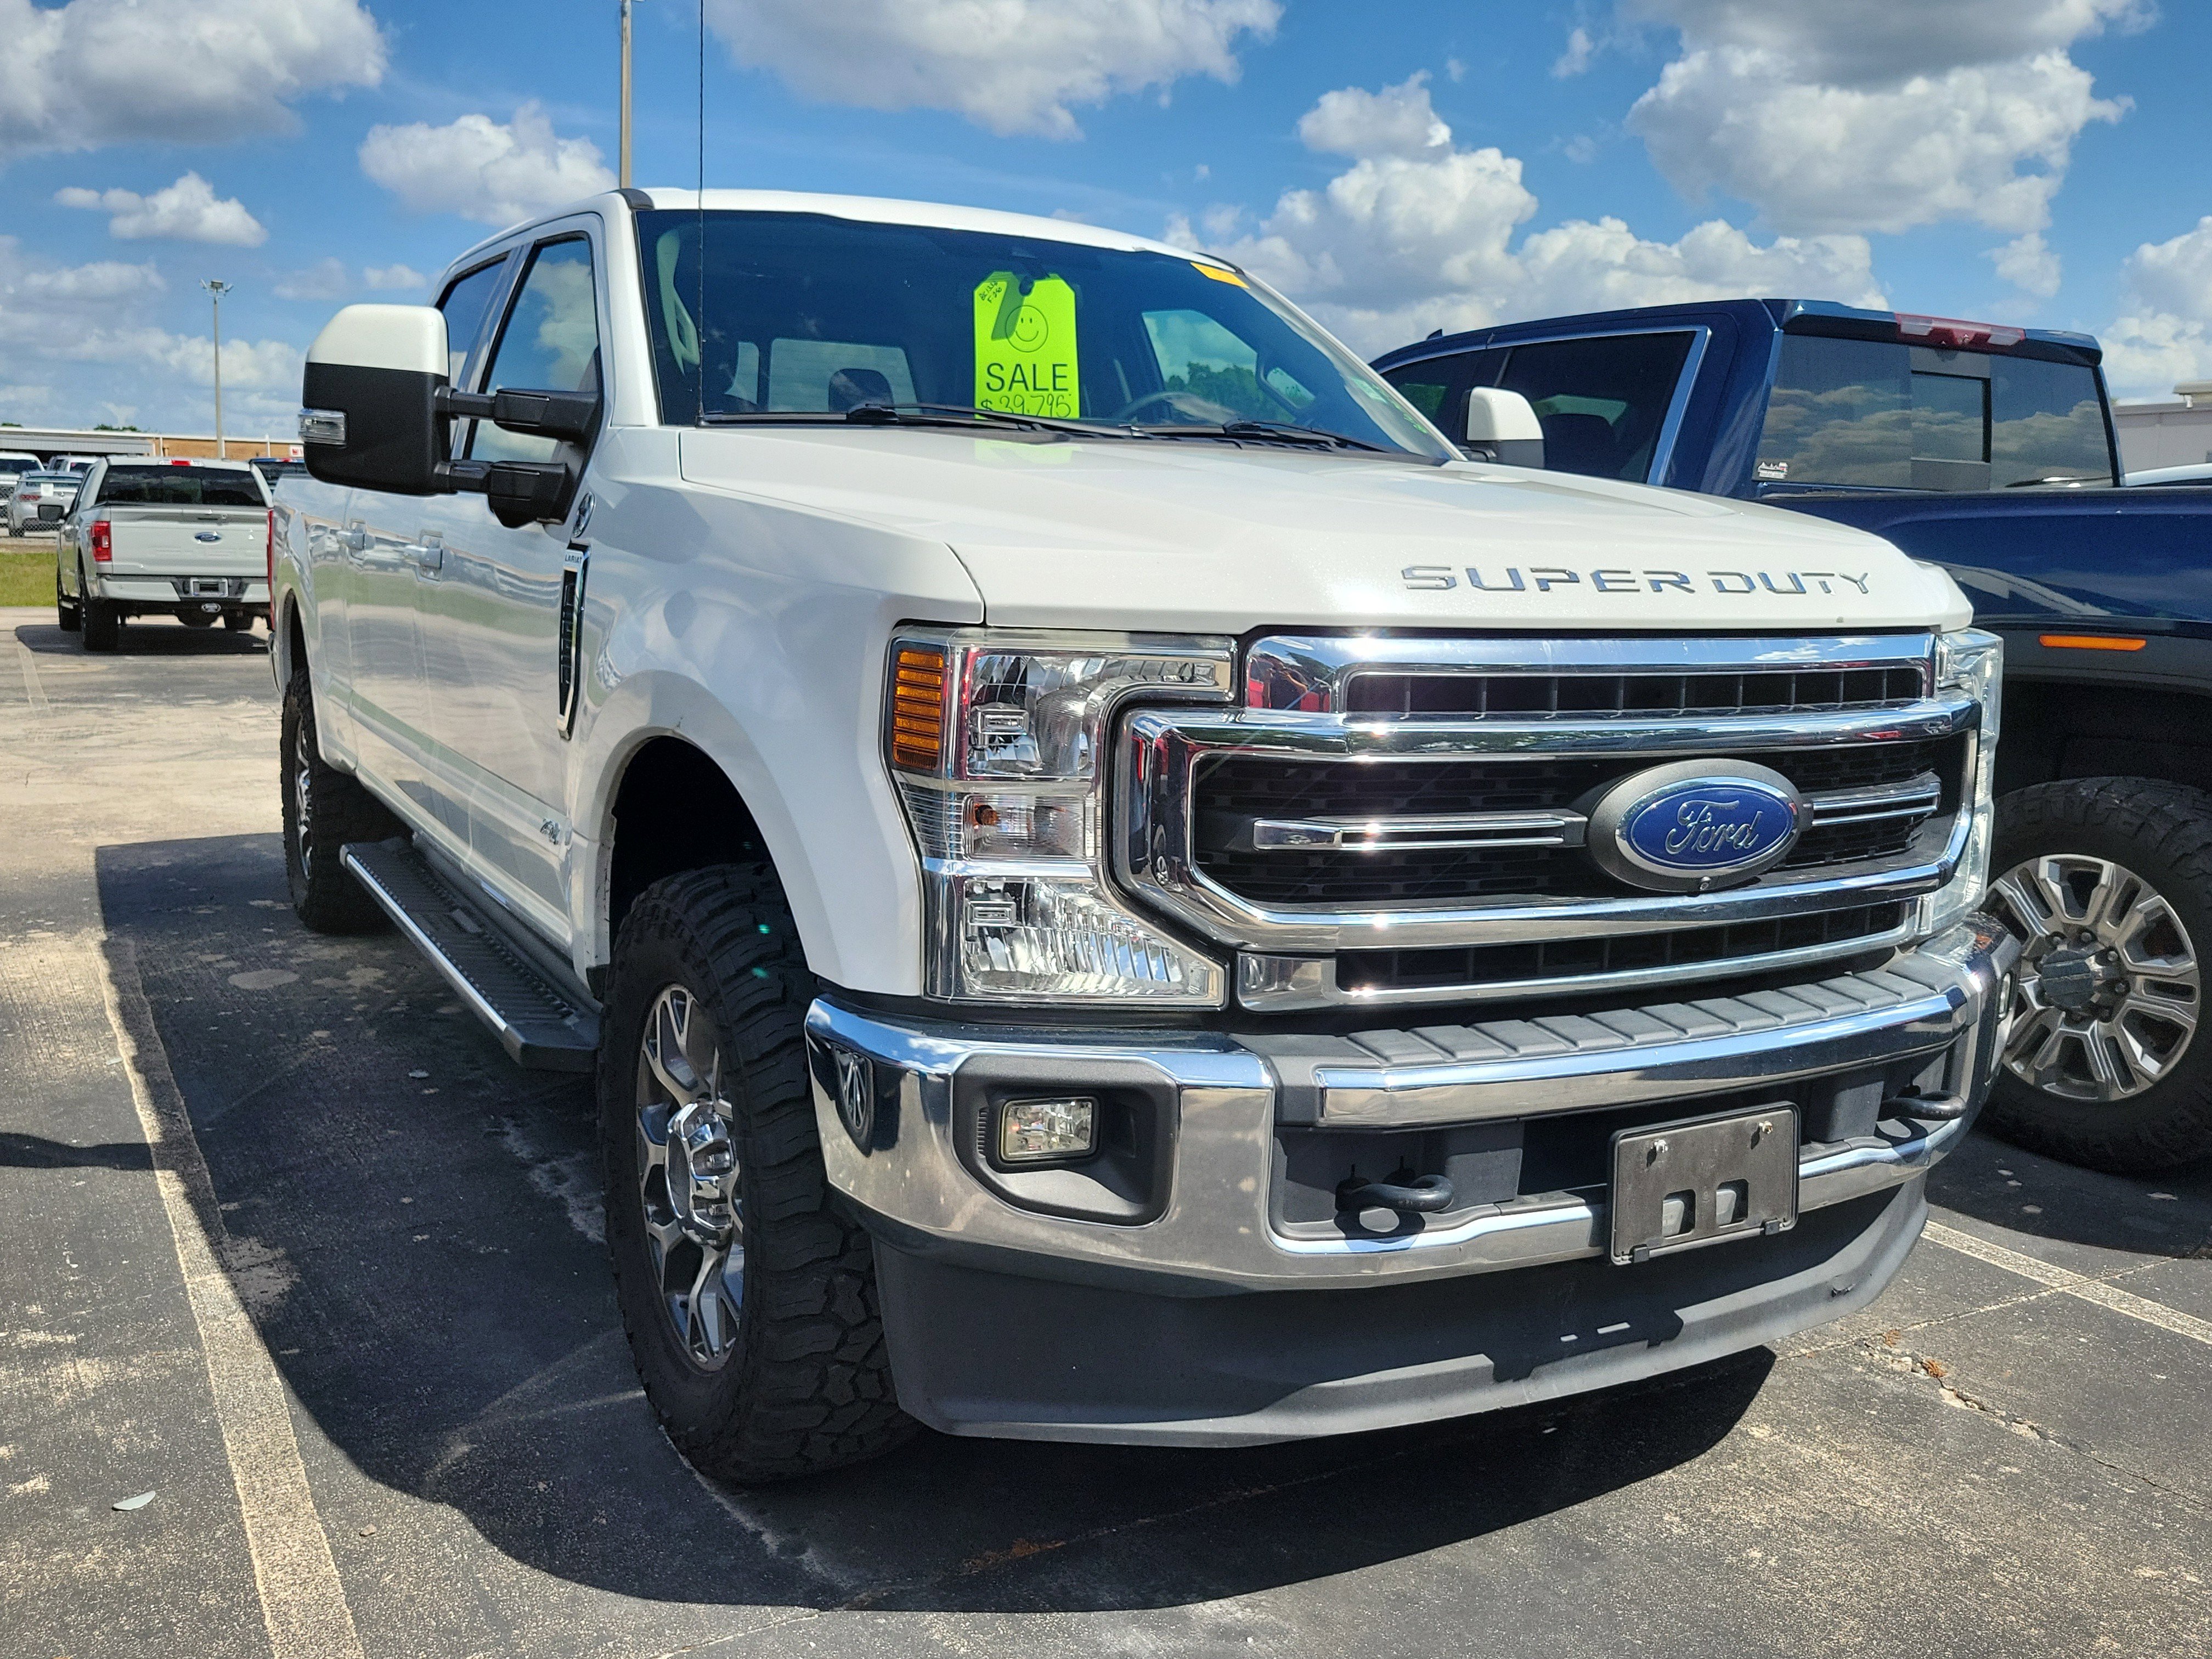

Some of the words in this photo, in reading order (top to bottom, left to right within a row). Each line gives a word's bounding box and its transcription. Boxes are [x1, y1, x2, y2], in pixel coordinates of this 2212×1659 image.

[986, 363, 1069, 392] SALE
[1401, 566, 1696, 594] SUPER
[1706, 570, 1869, 594] DUTY
[1665, 799, 1763, 855] Ford
